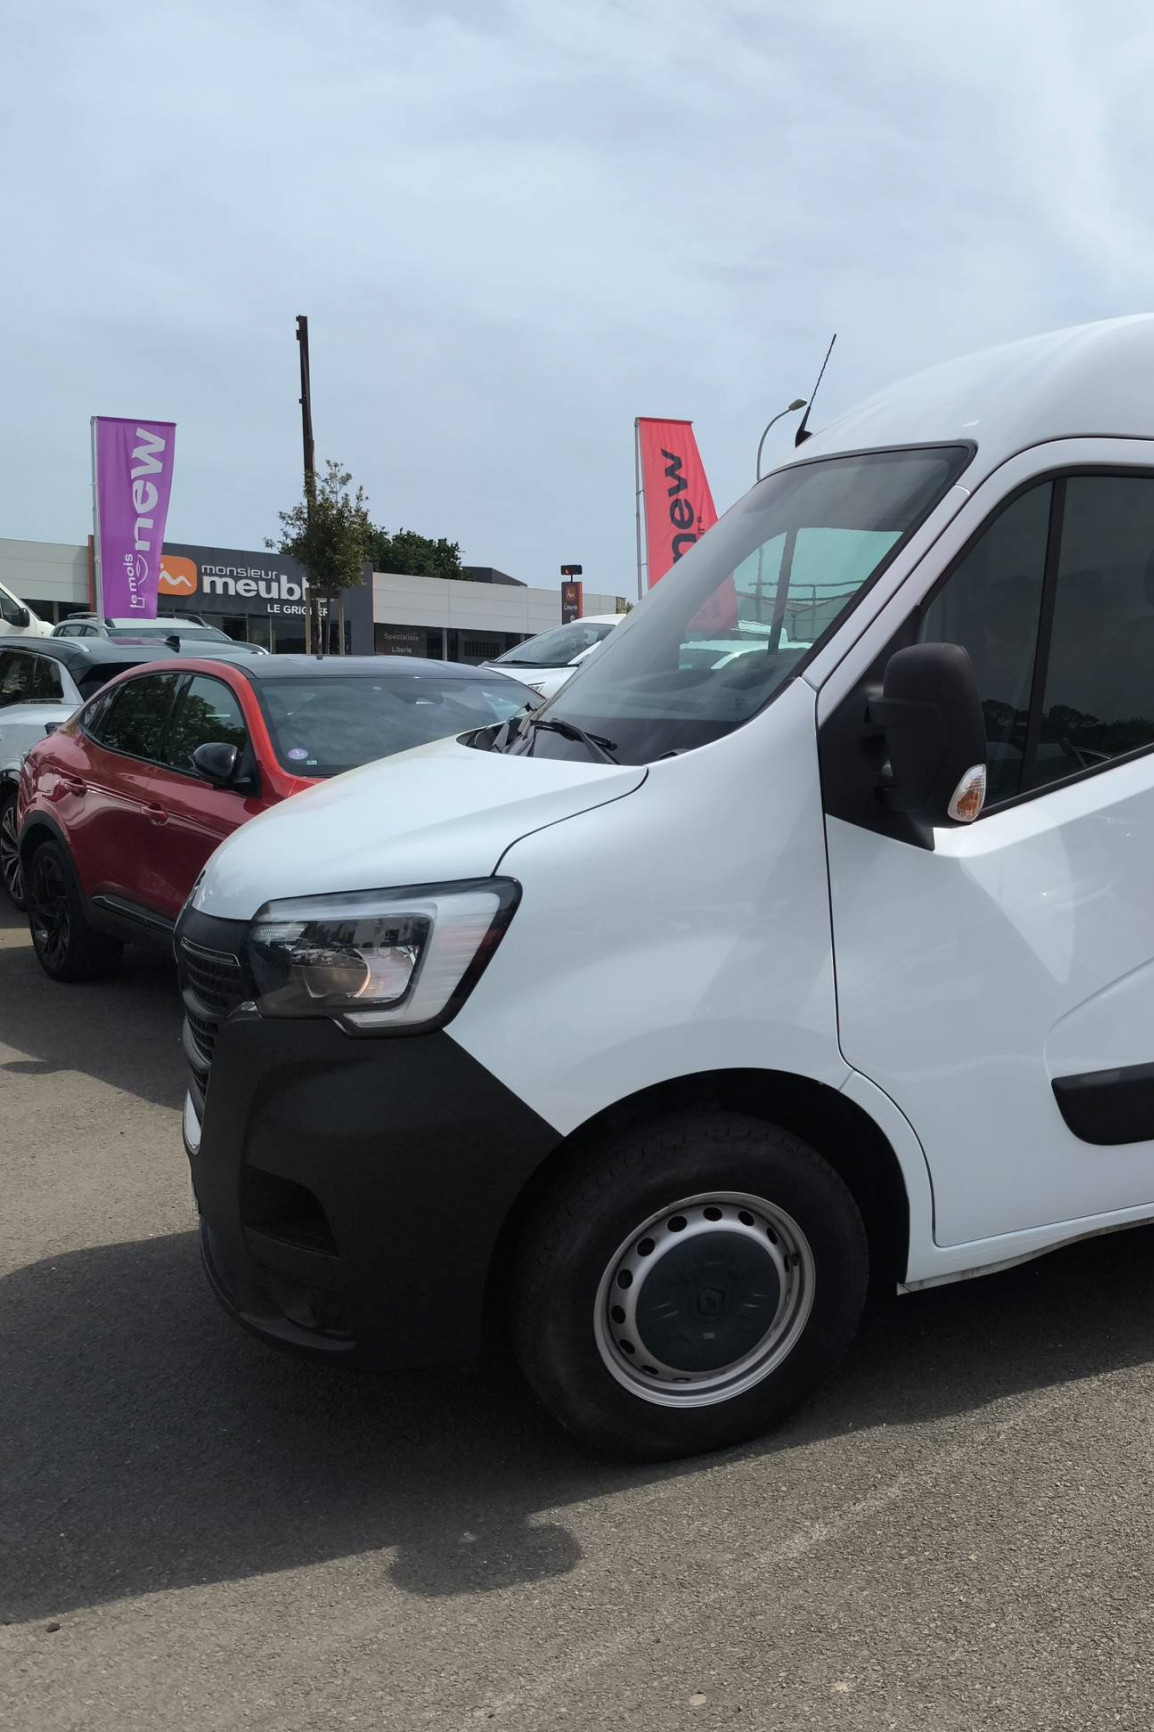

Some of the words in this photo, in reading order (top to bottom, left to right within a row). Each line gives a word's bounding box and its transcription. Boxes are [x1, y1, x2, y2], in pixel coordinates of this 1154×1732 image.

[123, 553, 137, 592] mois
[201, 564, 278, 579] monsieur
[202, 575, 320, 601] meubl
[267, 603, 281, 613] LE
